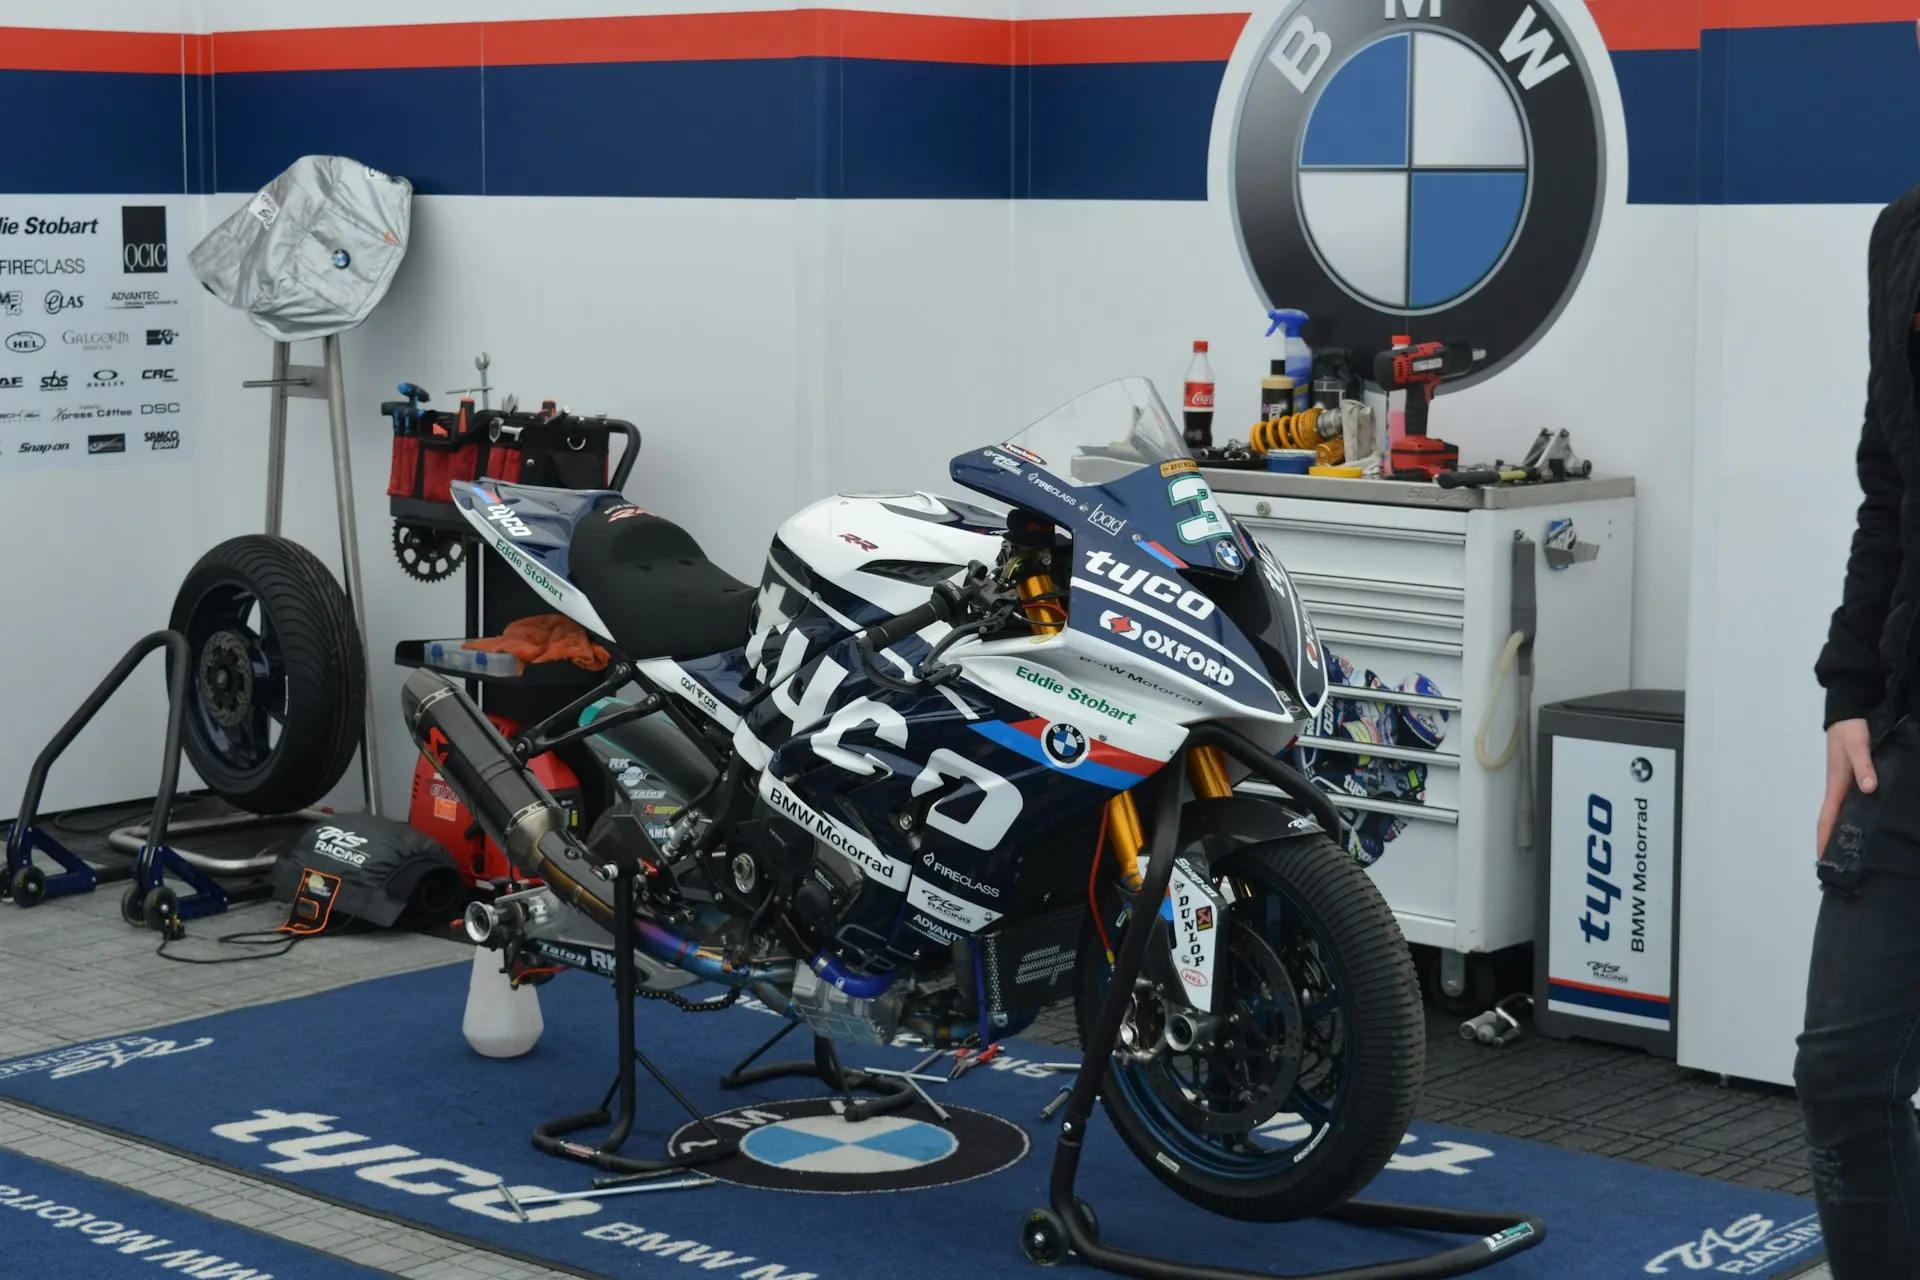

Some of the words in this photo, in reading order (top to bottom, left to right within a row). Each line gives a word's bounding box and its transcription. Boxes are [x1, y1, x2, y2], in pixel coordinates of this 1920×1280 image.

[0, 217, 19, 236] ie
[24, 216, 99, 235] Stobart
[0, 258, 86, 276] FIRECLASS
[124, 243, 167, 271] QCIC
[111, 291, 160, 302] ADVANTEC
[13, 340, 41, 349] HEL
[141, 403, 181, 415] DSC
[18, 442, 70, 455] Snap-on
[144, 430, 179, 442] SAMCO
[1033, 478, 1077, 506] FIRECLASS
[1168, 474, 1235, 545] 3
[1092, 509, 1122, 533] QCIC
[496, 539, 522, 568] Eddie
[524, 564, 564, 602] Stobart
[1085, 550, 1215, 621] tyco
[1142, 629, 1235, 687] OXFORD
[1015, 665, 1064, 694] Eddie
[1067, 687, 1138, 726] Stobart
[1127, 673, 1202, 706] Motorrad
[770, 787, 815, 826] BMW
[816, 821, 894, 878] Motorrad
[1633, 798, 1648, 892] Motorrad
[314, 840, 366, 865] RACING
[1578, 793, 1622, 943] tyco
[933, 861, 1000, 898] FIRECLASS
[1175, 857, 1220, 898] Snap-on
[913, 913, 964, 942] ADVANT
[927, 901, 973, 924] RACING
[1631, 896, 1646, 952] BMW
[1178, 895, 1205, 967] DUNLOP
[1593, 971, 1629, 983] RACING
[211, 1108, 602, 1223] tyco
[583, 1221, 756, 1270] BMW
[1716, 1222, 1822, 1275] RACIN
